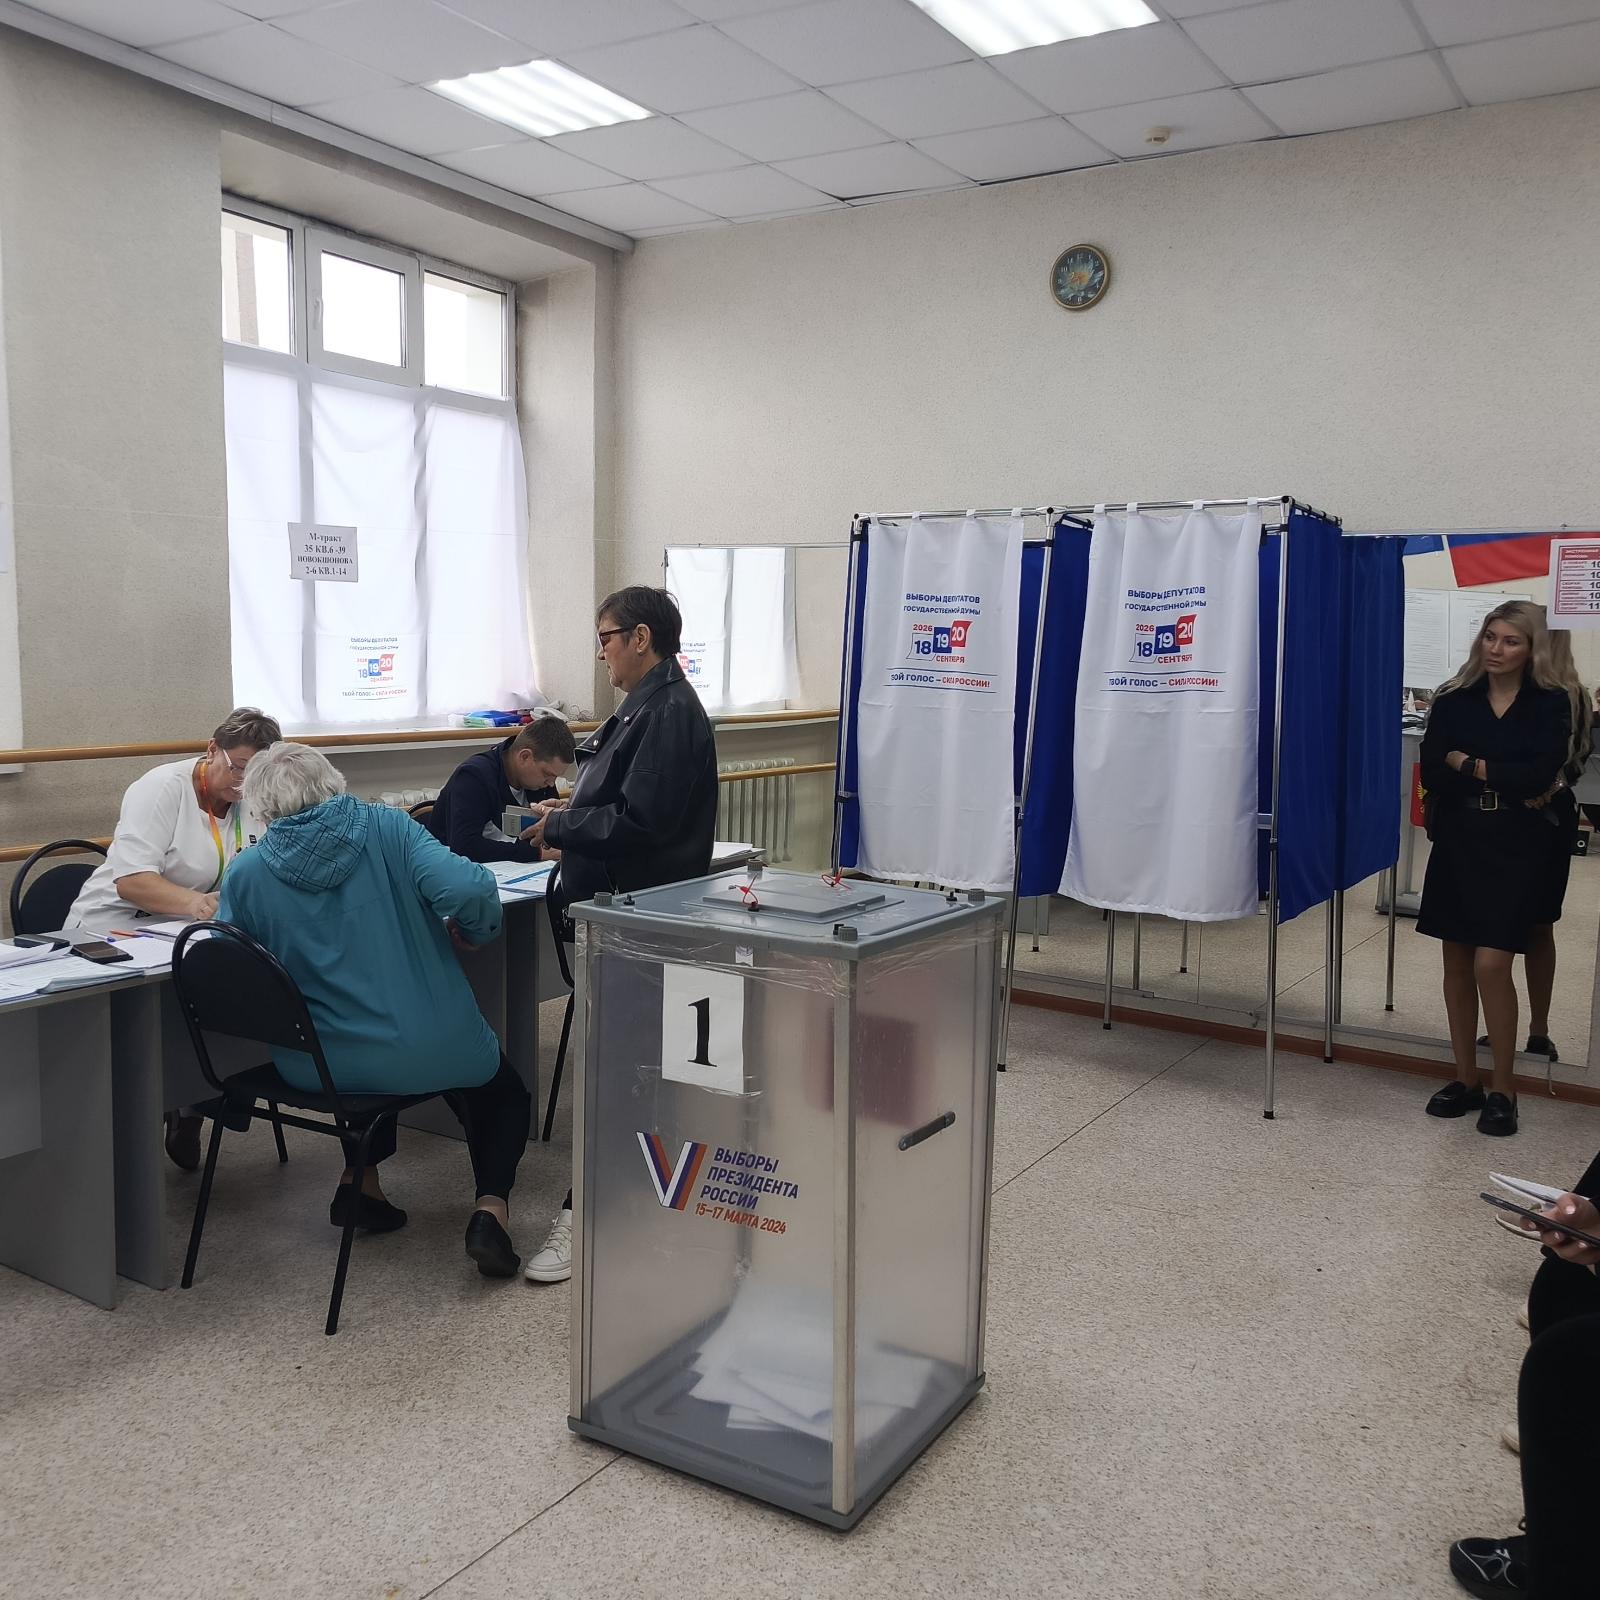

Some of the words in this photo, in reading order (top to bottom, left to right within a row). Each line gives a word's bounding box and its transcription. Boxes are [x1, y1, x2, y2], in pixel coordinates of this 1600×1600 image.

[304, 544, 314, 553] 35
[905, 593, 942, 603] ВЫБОРЫ
[1127, 589, 1163, 600] ВЫБОРЫ
[960, 606, 981, 616] ДУМЫ
[912, 623, 933, 632] 2026
[951, 626, 965, 642] 20
[1135, 623, 1155, 632] 2026
[1177, 622, 1192, 639] 20
[935, 633, 949, 648] 19
[1157, 632, 1174, 649] 19
[914, 640, 932, 655] 18
[1136, 641, 1153, 658] 18
[369, 662, 379, 673] 19
[379, 656, 392, 668] 20
[358, 668, 368, 679] 18
[906, 673, 934, 683] ГОЛОС
[1129, 678, 1159, 687] ГОЛОС
[687, 997, 718, 1067] 1
[713, 1147, 780, 1173] ВЫБОРЫ
[706, 1166, 799, 1199] ПРЕЗИДЕНТА
[700, 1184, 759, 1210] РОССИИ
[723, 1210, 761, 1229] МАРТА
[760, 1217, 787, 1235] 2024
